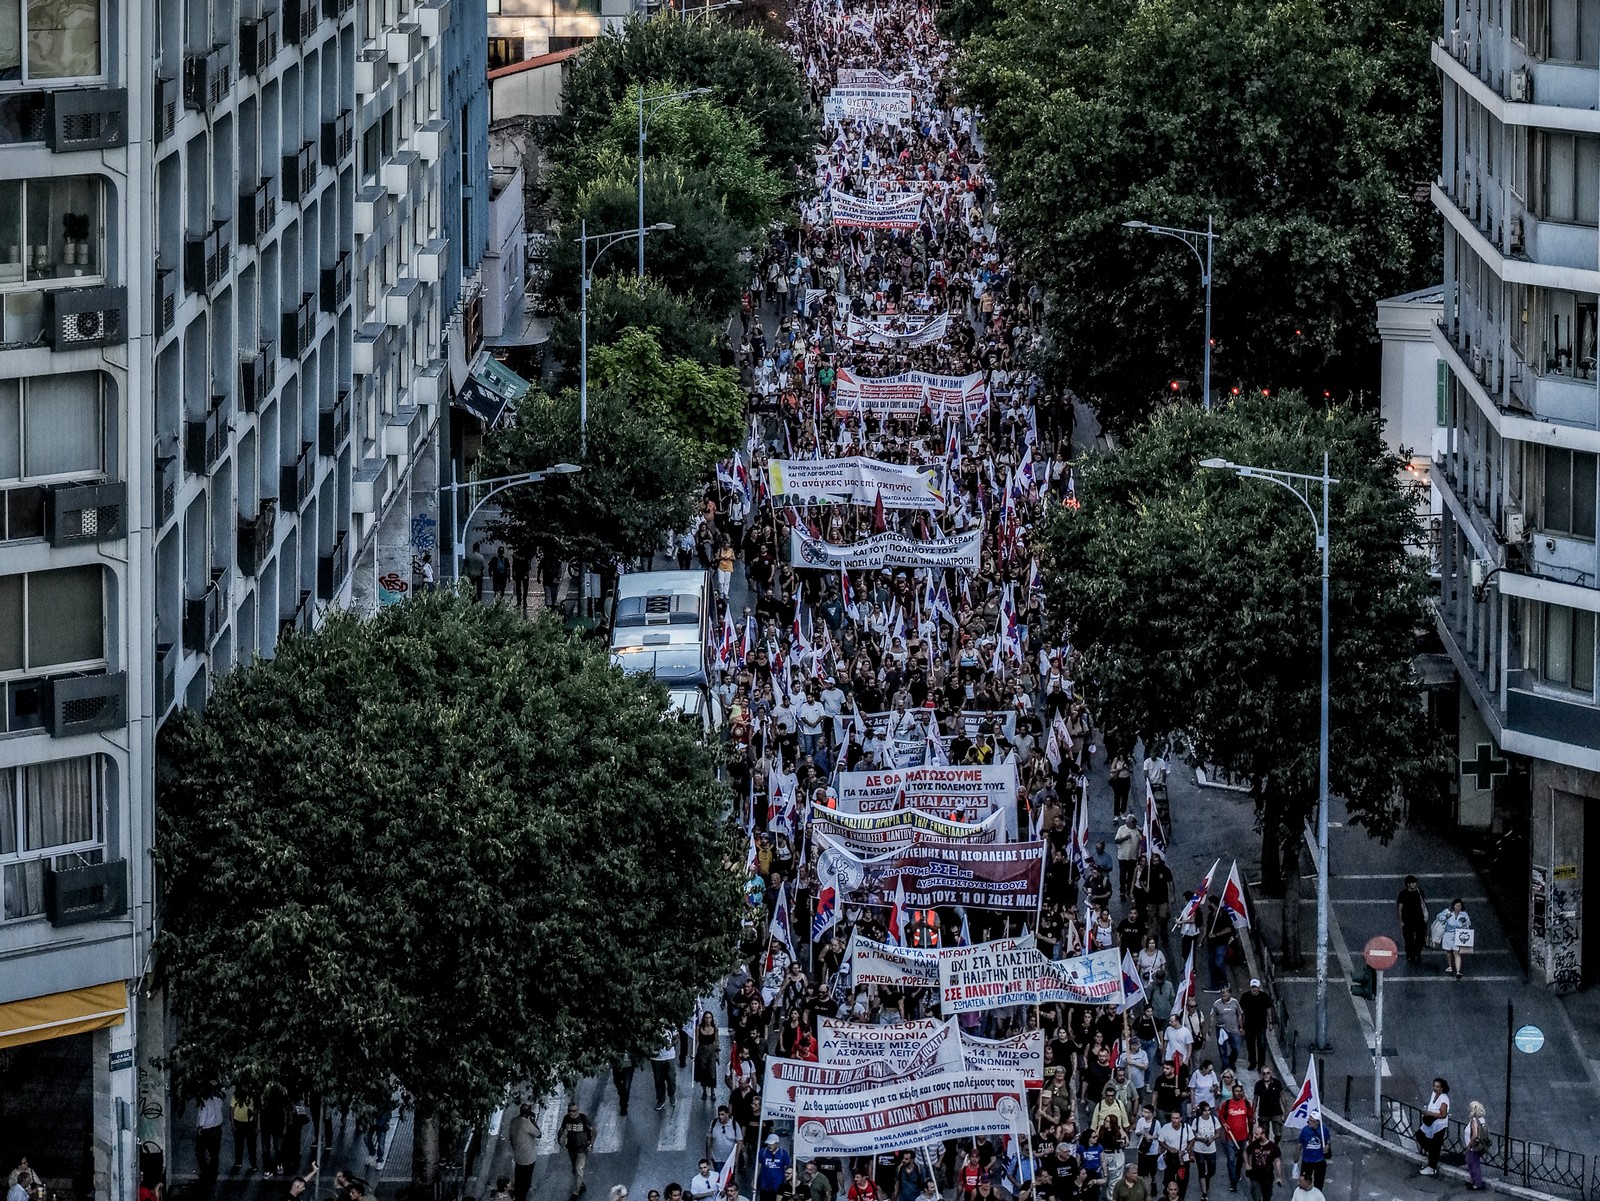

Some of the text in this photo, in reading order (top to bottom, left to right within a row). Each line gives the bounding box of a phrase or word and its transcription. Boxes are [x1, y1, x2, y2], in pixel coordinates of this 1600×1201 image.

[802, 478, 842, 488] ανάγκες
[844, 479, 859, 488] μας
[860, 479, 874, 488] επί
[877, 482, 912, 492] σκηνής
[949, 535, 974, 544] ΚΕΡΔΗ
[853, 543, 959, 556] ΚΑΙ ΠΟΛΕΜΟΥΣ ΤΟΥΣ
[869, 557, 881, 566] ΚΑΙ
[920, 557, 934, 565] ΤΗΝ
[936, 557, 974, 565] ΑΝΑΤΡΟΠΗ
[866, 769, 982, 786] ΔΕ ΘΑ ΜΑΤΩΣΟΥΜΕ
[844, 789, 856, 797] ΓΙΑ
[870, 786, 896, 796] ΚΕΡΔΗ
[912, 782, 933, 791] ΤΟΥΣ
[935, 783, 982, 791] ΠΟΛΕΜΟΥΣ
[984, 782, 1005, 791] ΤΟΥΣ
[920, 795, 987, 807] ΚΑΙ ΑΓΩΝΑΣ
[840, 816, 873, 829] ΕΛΑΣΤΙΚΑ
[886, 828, 912, 842] ΠΑΝΤΟΥ
[942, 849, 959, 860] ΚΑΙ
[961, 850, 1018, 862] ΑΣΦΑΛΕΙΑΣ
[959, 870, 974, 878] ΜΕ
[916, 877, 1027, 891] ΑΥΞΗΣΕΙΣ ΣΤΟΥΣ ΜΙΣΘΟΥΣ
[905, 891, 931, 905] ΕΡΔΗ
[932, 890, 957, 903] ΤΟΥΣ
[973, 892, 985, 904] ΟΙ
[988, 893, 1014, 905] ΖΩΕΣ
[1016, 894, 1037, 907] ΜΑΣ
[855, 940, 888, 952] ΔΩΣΤΕ
[892, 947, 924, 958] ΛΕΦΤΑ
[989, 940, 1017, 953] ΥΓΕΙΑ
[857, 951, 907, 965] ΚΑΙ ΠΑΙΔΕΙΑ
[951, 951, 1043, 972] ΟΧΙ ΣΤΑ ΕΛΑΣΤΙΚΑ
[857, 974, 893, 984] ΣΩΜΑΤΕΙΑ
[902, 976, 929, 986] ΦΟΡΕΙΣ
[963, 968, 1008, 985] ΚΑΙ ΤΗΝ
[944, 986, 962, 1001] ΣΣΕ
[965, 982, 1005, 998] ΠΑΝΤΟΥ
[1007, 981, 1022, 993] ΜΕ
[953, 998, 985, 1011] ΣΩΜΑΤΕΙΑ
[833, 1030, 928, 1041] ΣΥΓΚΟΙΝΩΝΙΑ
[822, 1040, 886, 1049] ΑΥΞΗΣΕΙΣ
[889, 1041, 921, 1050] ΜΙΣΘ
[836, 1048, 885, 1057] ΑΣΦΑΛΗΣ
[781, 1063, 805, 1081] ΠΑΛΗ
[808, 1067, 821, 1084] ΓΙΑ
[825, 1069, 835, 1085] ΤΗ
[838, 1069, 853, 1084] ΖΩΗ
[803, 1100, 813, 1111] Δε
[813, 1100, 823, 1111] θα
[824, 1099, 870, 1114] ματώσουμε
[871, 1096, 886, 1108] για
[887, 1094, 898, 1102] τα
[919, 1086, 931, 1096] και
[933, 1081, 951, 1092] τους
[953, 1076, 996, 1090] πολέμους
[997, 1079, 1015, 1088] τους
[825, 1115, 867, 1134] ΟΡΓΑΝΩΣΗ
[868, 1112, 886, 1129] ΚΑΙ
[888, 1106, 918, 1125] ΑΓΩΝΑΣ
[928, 1099, 945, 1116] ΤΗΝ
[948, 1094, 995, 1112] ΑΝΑΤΡΟΠΗ
[813, 1145, 873, 1153] ΕΡΓΑΤΟΤΕΧΝΙΤΩΝ
[880, 1136, 923, 1149] ΥΠΑΛΛΗΛΩΝ
[943, 1126, 980, 1135] ΤΡΟΦΙΜΩΝ
[874, 1129, 918, 1142] ΠΑΝΕΛΛΗΝΙΑ
